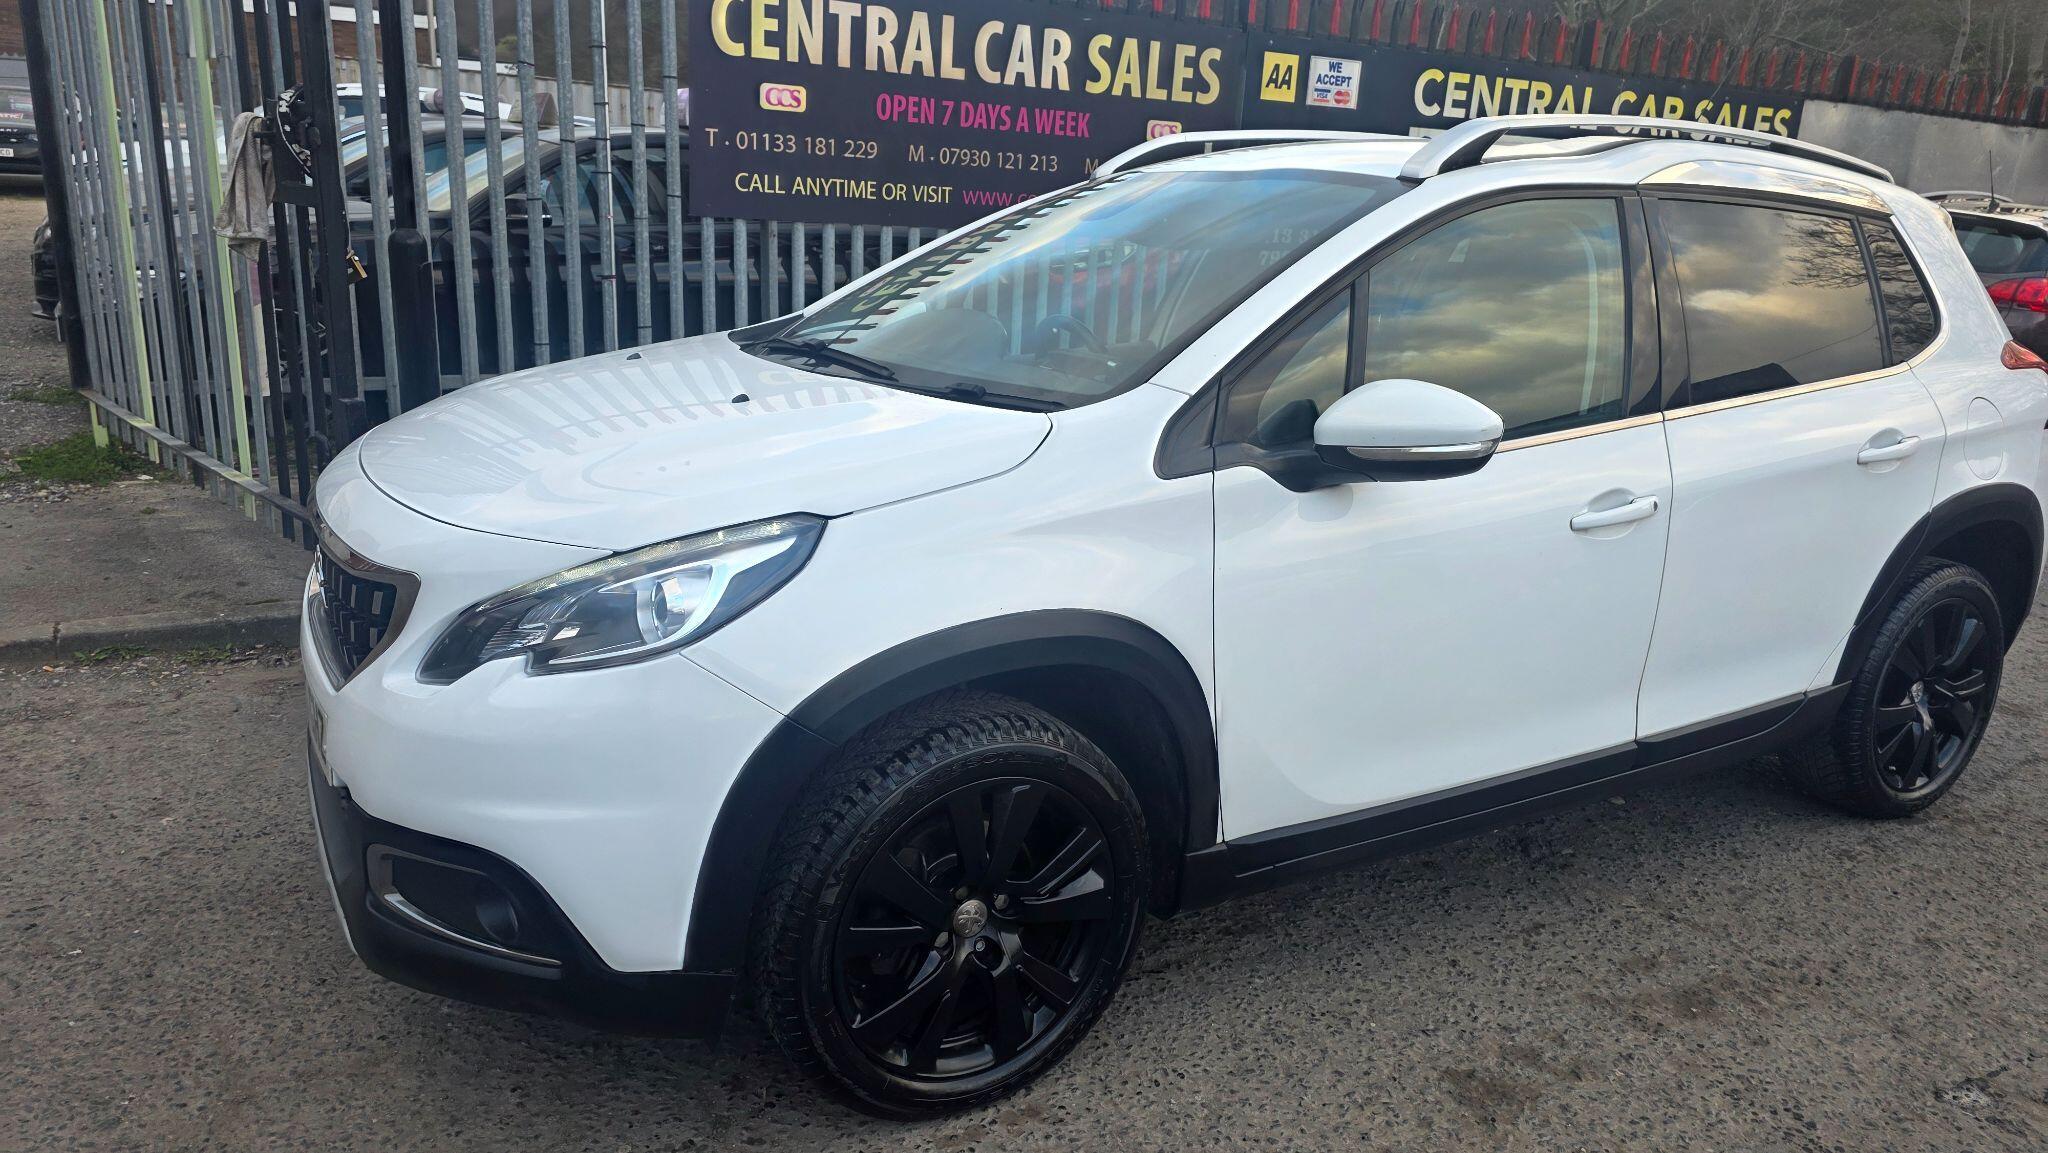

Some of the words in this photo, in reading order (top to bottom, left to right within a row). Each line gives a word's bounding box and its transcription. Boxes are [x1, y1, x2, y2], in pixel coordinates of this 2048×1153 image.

[711, 0, 965, 81] CENTRAL
[974, 20, 1072, 91] CAR
[1085, 34, 1222, 105] SALES
[1265, 63, 1293, 91] AA
[1315, 73, 1353, 88] ACCEPT
[1328, 61, 1343, 74] WE
[1316, 92, 1329, 100] VISA
[1414, 68, 1597, 130] CENTRAL
[1611, 91, 1684, 138] CAR
[1690, 100, 1792, 146] SALES
[876, 93, 935, 125] OPEN
[941, 100, 955, 126] 7
[960, 102, 1012, 132] DAYS
[1015, 107, 1030, 133] A
[1035, 108, 1091, 138] WEEK
[736, 131, 797, 153] 01133
[805, 137, 835, 156] 181
[844, 139, 878, 159] 229
[939, 147, 991, 167] 07930
[997, 151, 1023, 170] 121
[1029, 154, 1058, 172] 213
[735, 172, 786, 194] CALL
[791, 176, 877, 199] ANYTIME
[882, 183, 907, 201] OR
[912, 184, 953, 204] VISIT
